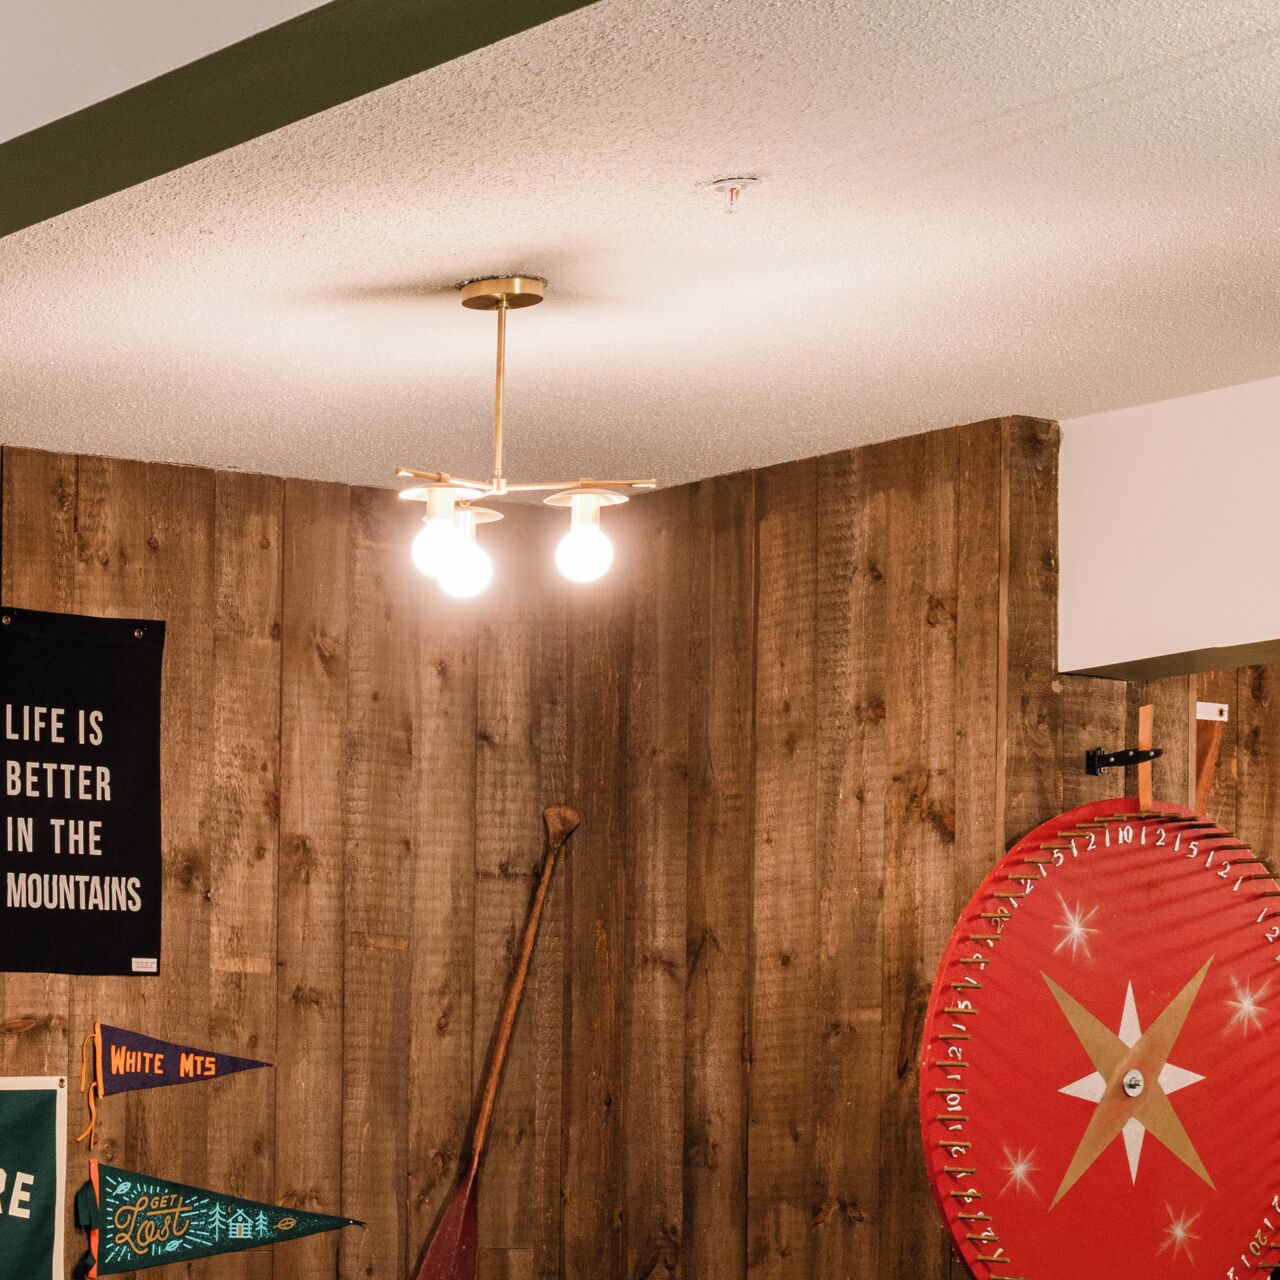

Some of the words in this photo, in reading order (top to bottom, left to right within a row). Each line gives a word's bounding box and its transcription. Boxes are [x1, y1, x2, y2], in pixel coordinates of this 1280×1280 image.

[6, 704, 65, 744] LIFE
[78, 709, 104, 746] IS
[6, 760, 111, 801] BETTER
[7, 816, 33, 853] IN
[50, 819, 103, 856] THE
[1086, 833, 1097, 851] 2
[1105, 829, 1110, 847] 1
[1118, 826, 1133, 844] 10
[1141, 826, 1146, 845] 1
[1156, 828, 1166, 846] 2
[1175, 833, 1182, 852] 1
[1071, 839, 1078, 857] 1
[1186, 841, 1199, 859] 5
[1052, 850, 1064, 867] 5
[1206, 850, 1215, 868] 1
[1217, 860, 1231, 878] 2
[6, 872, 141, 912] MOUNTAINS
[1233, 876, 1244, 891] 1
[1256, 908, 1268, 922] 1
[1265, 926, 1279, 942] 2
[947, 1046, 963, 1060] 2
[946, 1093, 962, 1112] 10
[150, 1194, 178, 1209] GET
[114, 1196, 193, 1255] Lost
[1249, 1228, 1268, 1256] 20
[1241, 1254, 1251, 1269] 1
